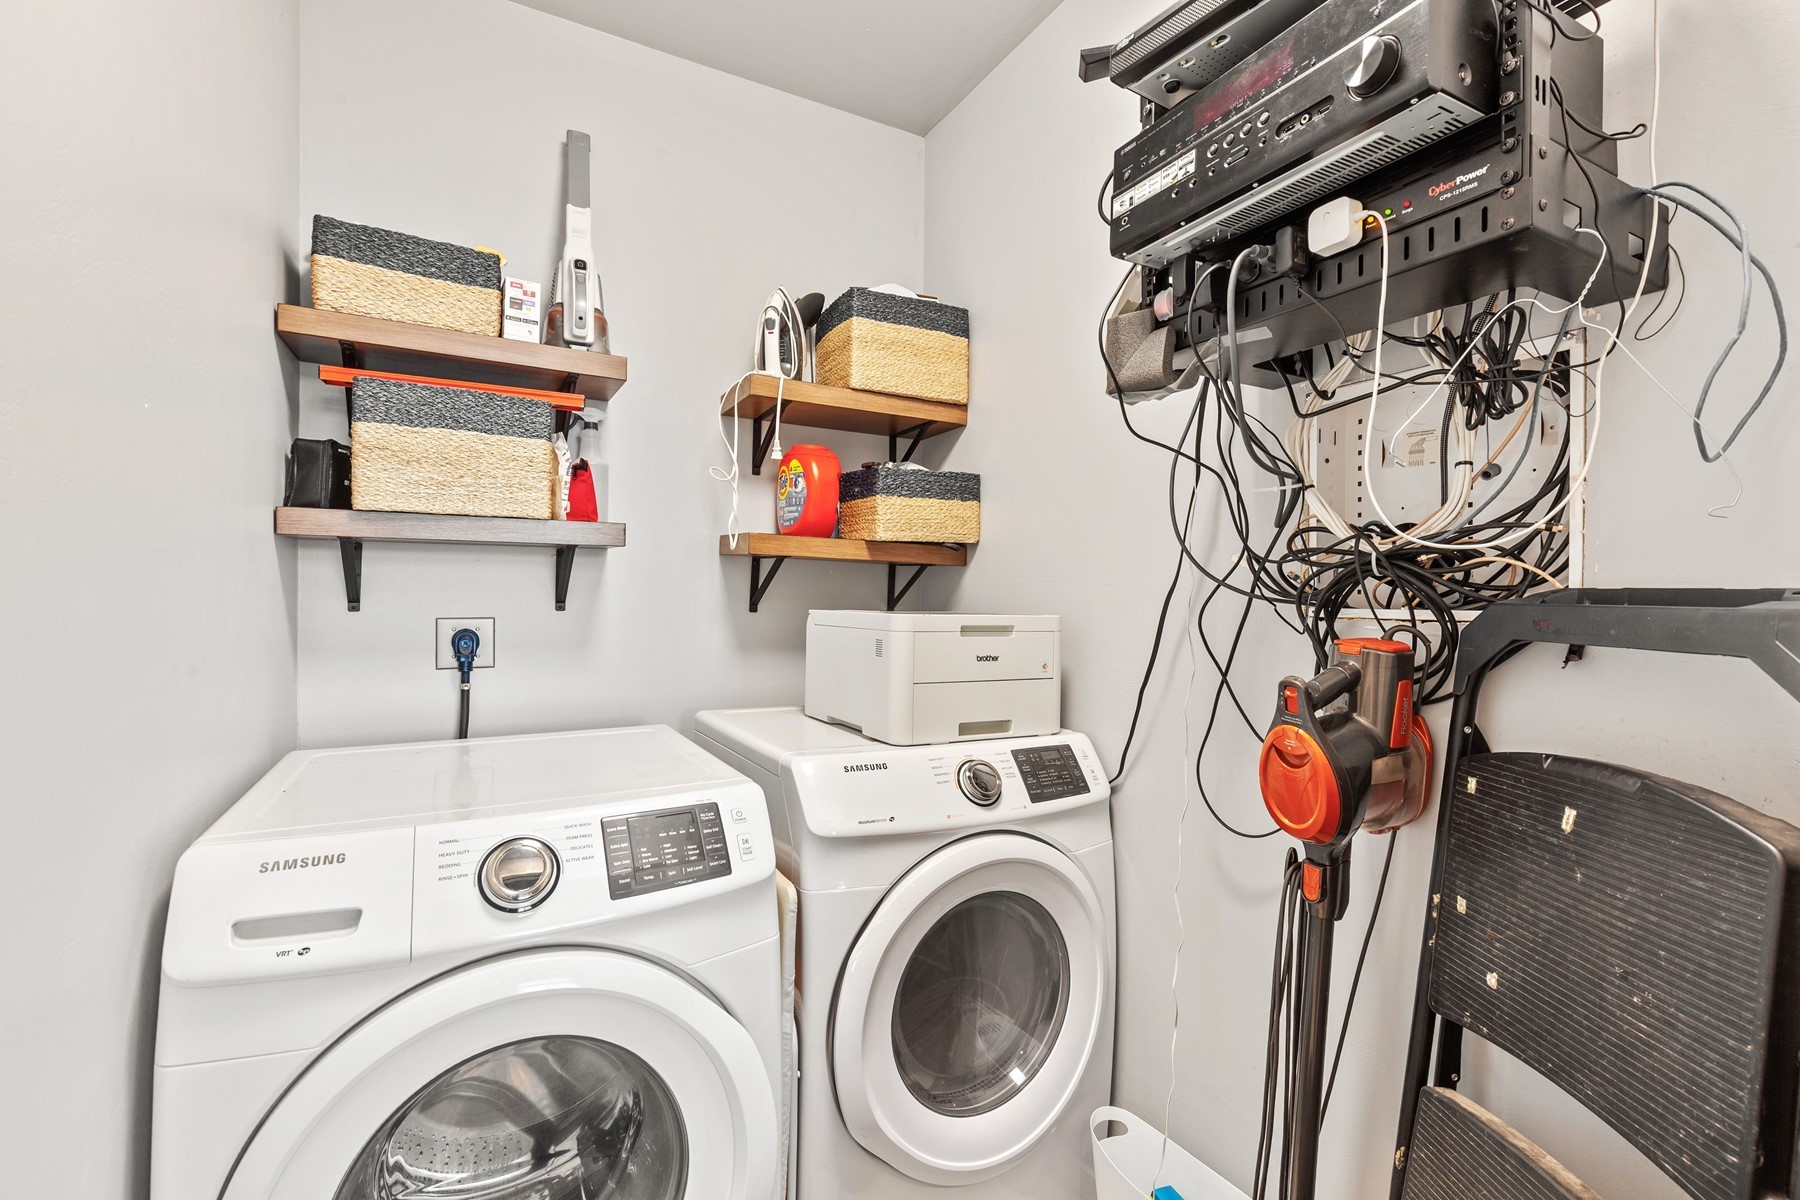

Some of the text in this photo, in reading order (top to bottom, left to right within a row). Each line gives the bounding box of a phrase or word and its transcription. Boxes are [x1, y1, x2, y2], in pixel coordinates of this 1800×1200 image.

[1428, 164, 1489, 196] CyberPower
[1400, 696, 1409, 735] Rocket
[843, 762, 888, 773] SAMSUNG
[259, 853, 346, 873] SAMSUNG
